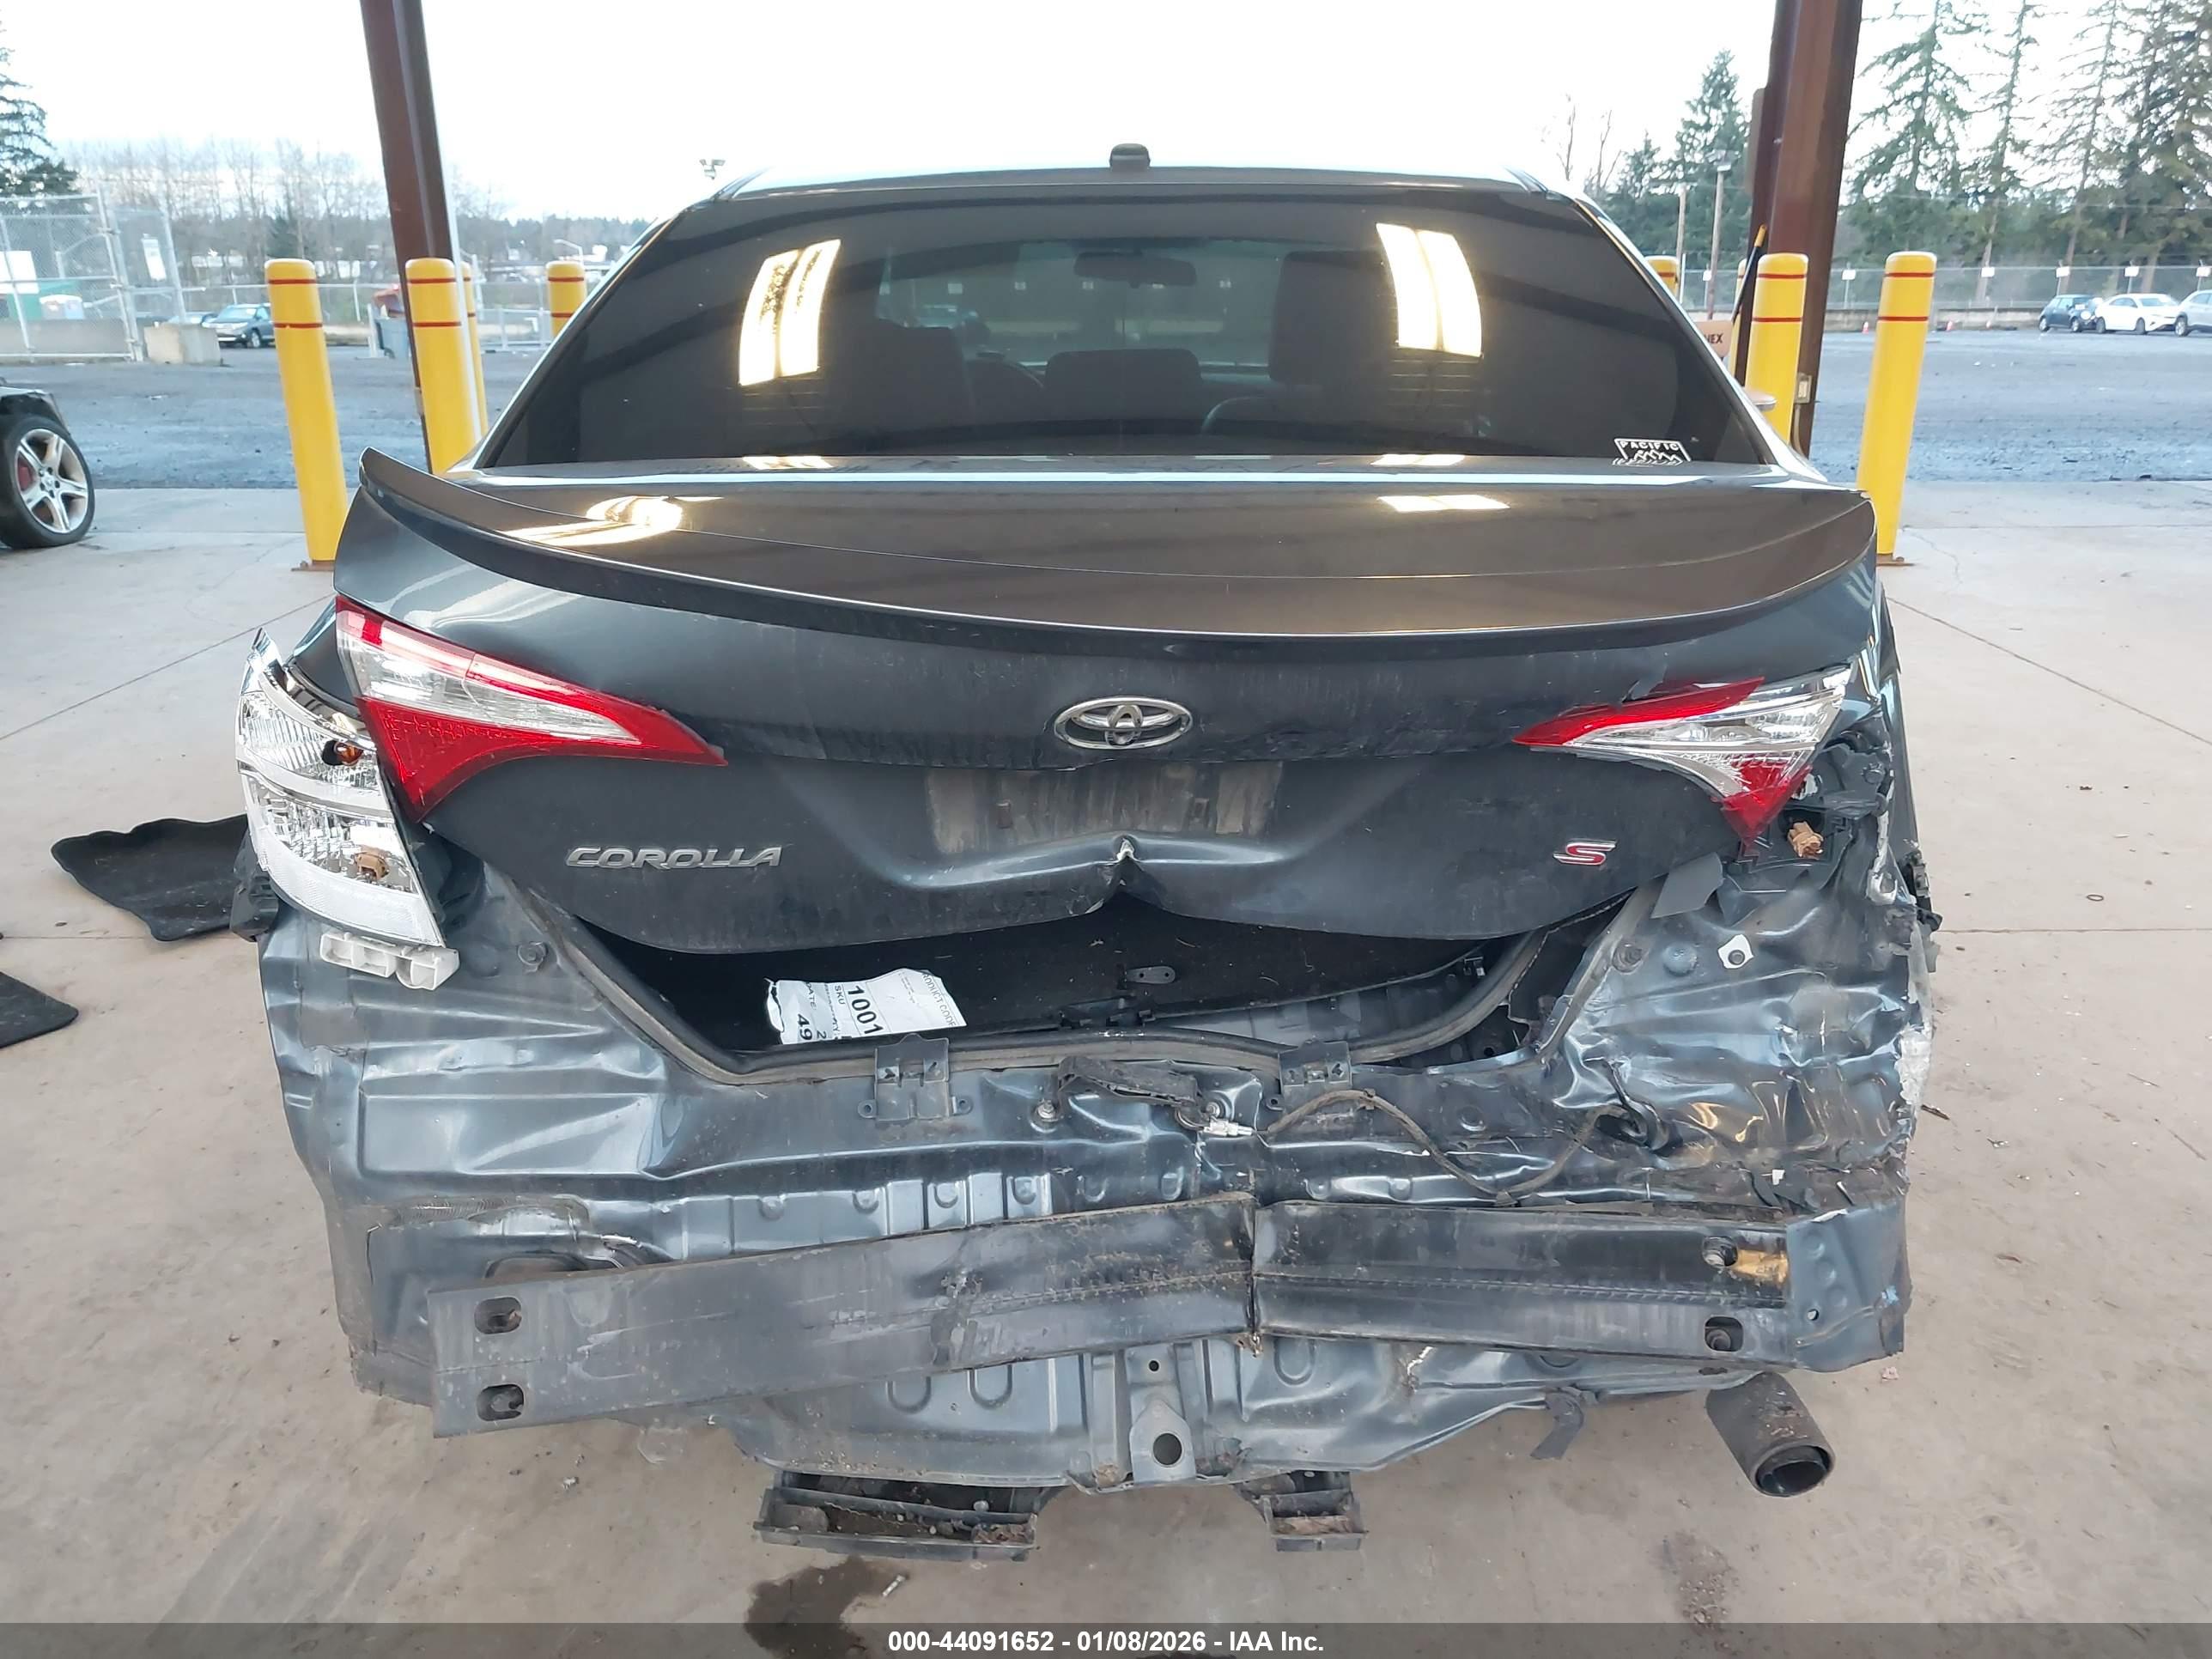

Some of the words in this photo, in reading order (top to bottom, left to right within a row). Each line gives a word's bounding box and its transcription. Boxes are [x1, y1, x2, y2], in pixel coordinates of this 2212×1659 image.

[1620, 441, 1679, 451] PACIFIC
[566, 847, 782, 870] COROLLA
[1553, 841, 1616, 866] S
[835, 985, 846, 1005] SKU
[848, 985, 884, 1034] 1001
[797, 1013, 812, 1041] 49
